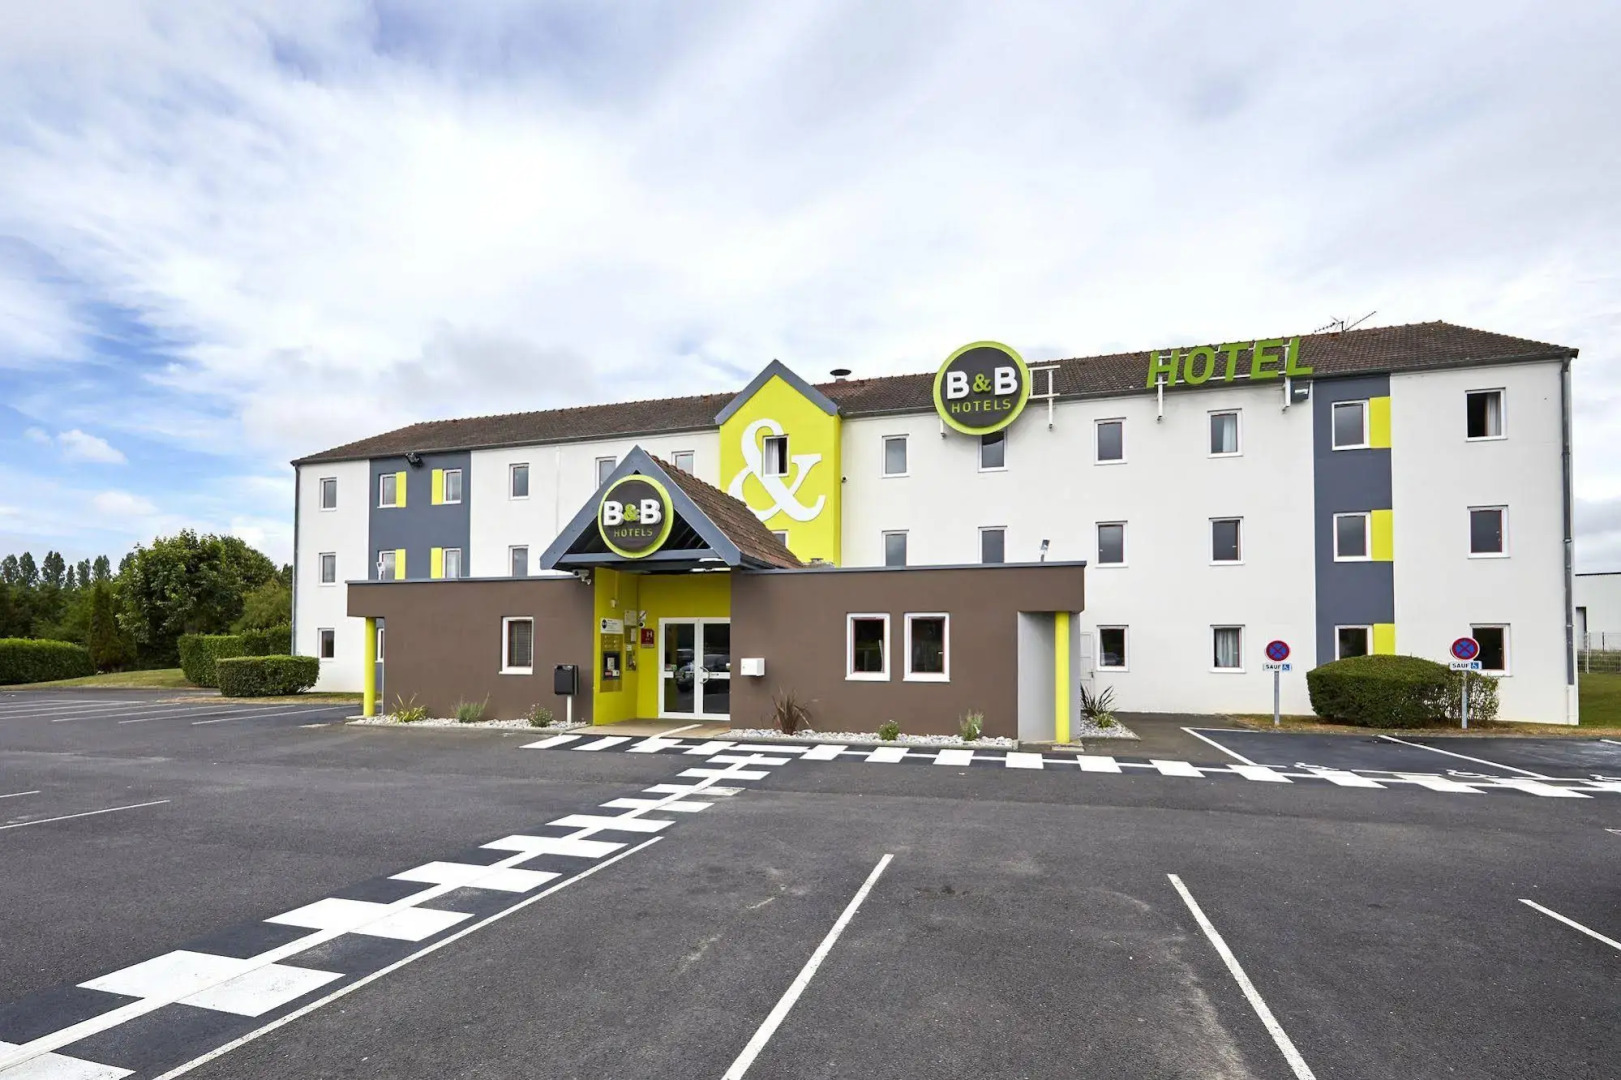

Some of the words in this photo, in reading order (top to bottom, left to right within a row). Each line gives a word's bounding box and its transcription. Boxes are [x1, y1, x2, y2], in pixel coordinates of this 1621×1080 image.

[1146, 336, 1313, 388] HOTEL
[946, 366, 1019, 400] B&B
[951, 398, 1012, 414] HOTELS
[603, 498, 662, 526] B&B
[614, 528, 653, 537] HOTELS
